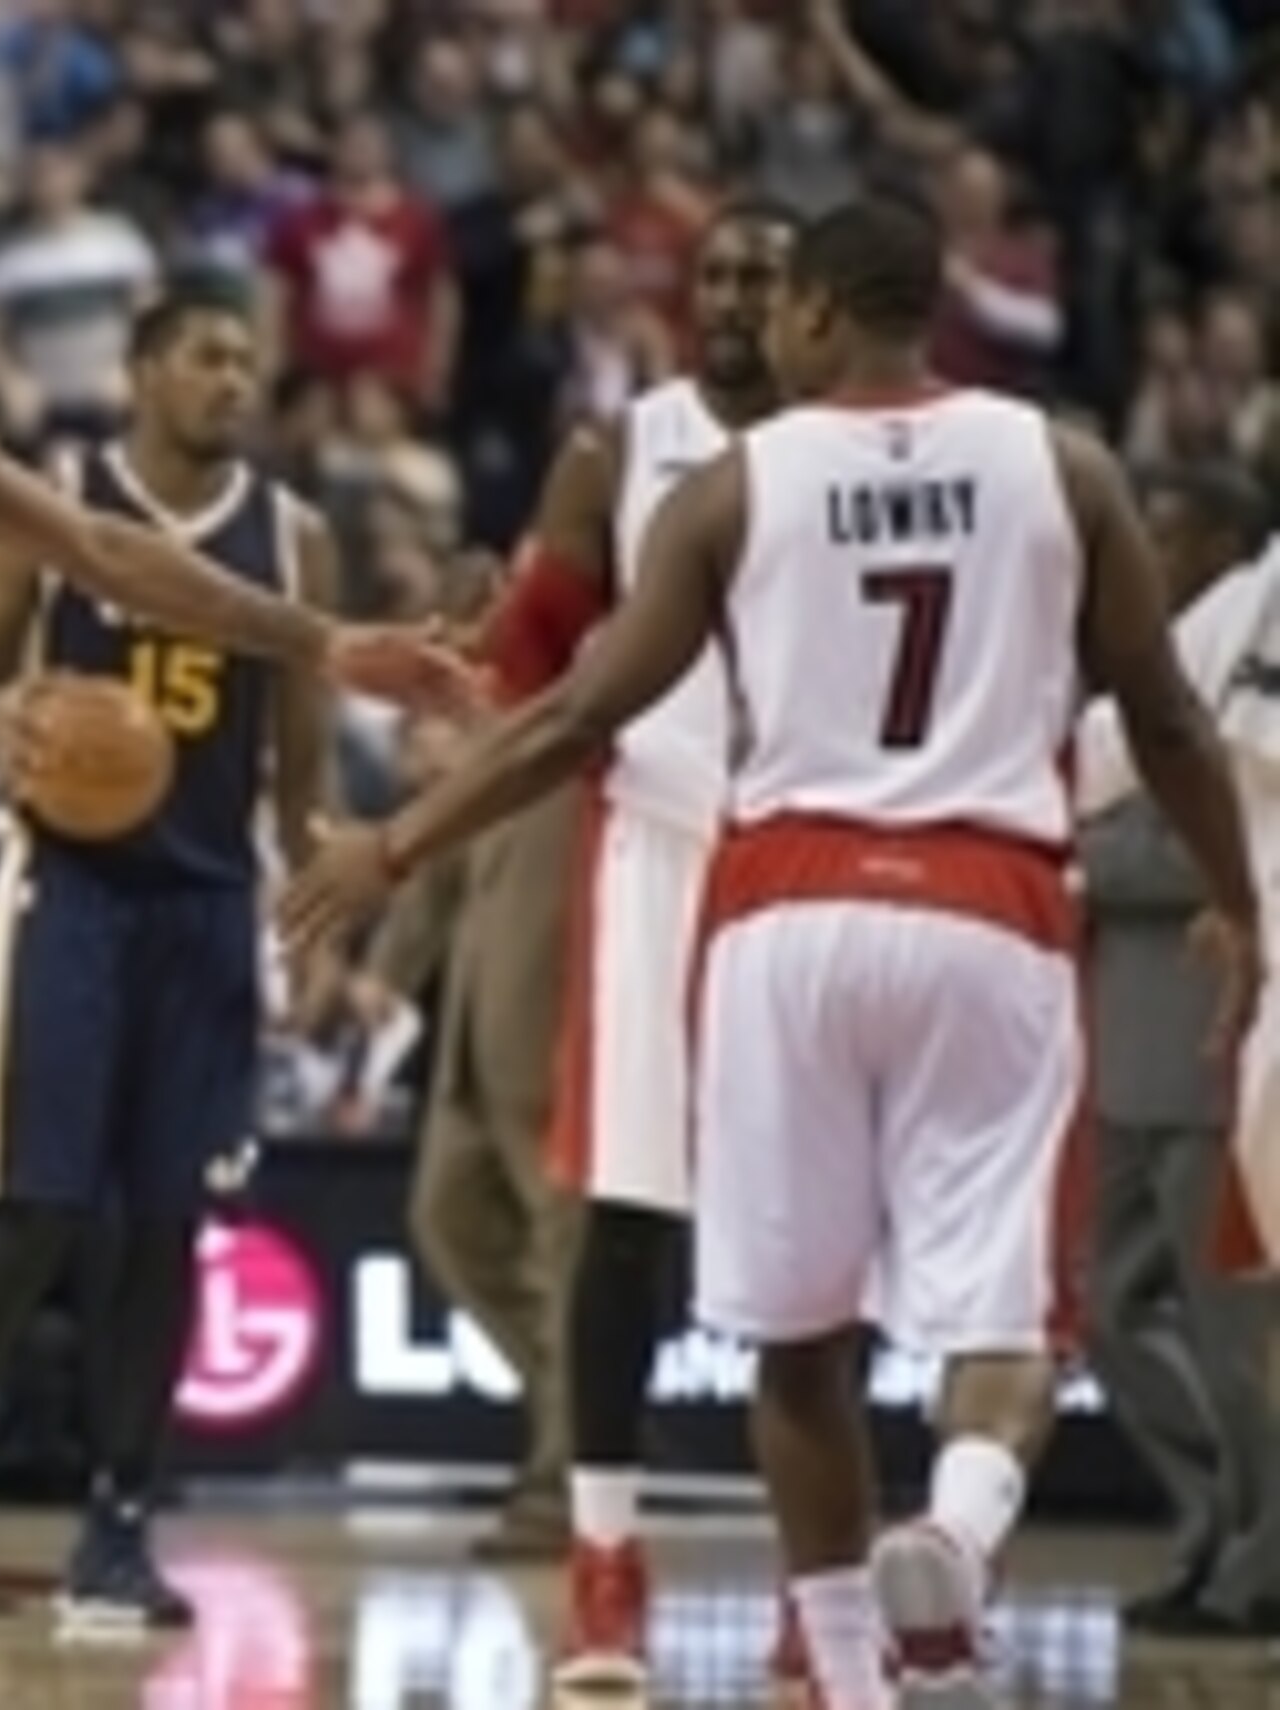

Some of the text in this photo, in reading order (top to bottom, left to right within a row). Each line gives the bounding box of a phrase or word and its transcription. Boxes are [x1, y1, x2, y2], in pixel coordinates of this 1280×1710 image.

[827, 478, 976, 545] LOWRY
[129, 642, 225, 731] 15
[858, 563, 955, 754] 7
